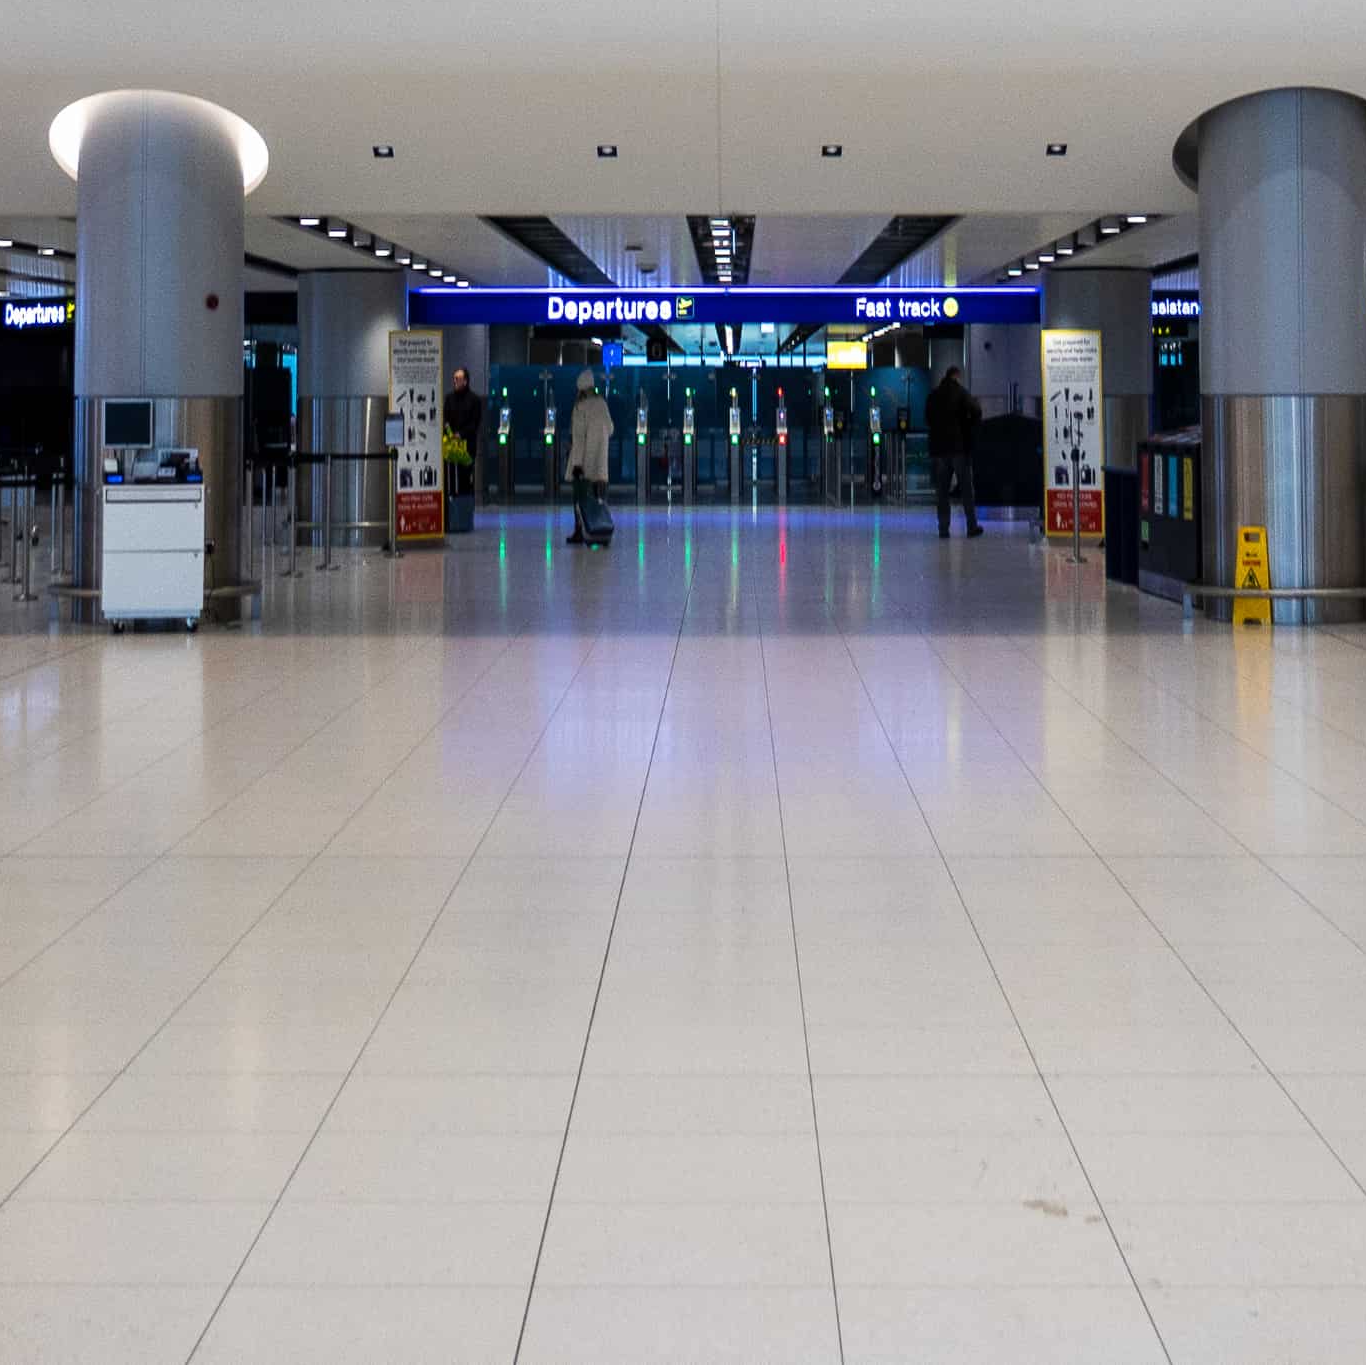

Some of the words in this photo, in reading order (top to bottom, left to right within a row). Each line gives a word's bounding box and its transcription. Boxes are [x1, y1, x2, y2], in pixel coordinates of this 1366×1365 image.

[5, 302, 65, 329] Departures
[547, 296, 672, 325] Departures
[856, 297, 891, 318] Fast
[898, 297, 941, 318] track
[1151, 298, 1202, 315] ssistan
